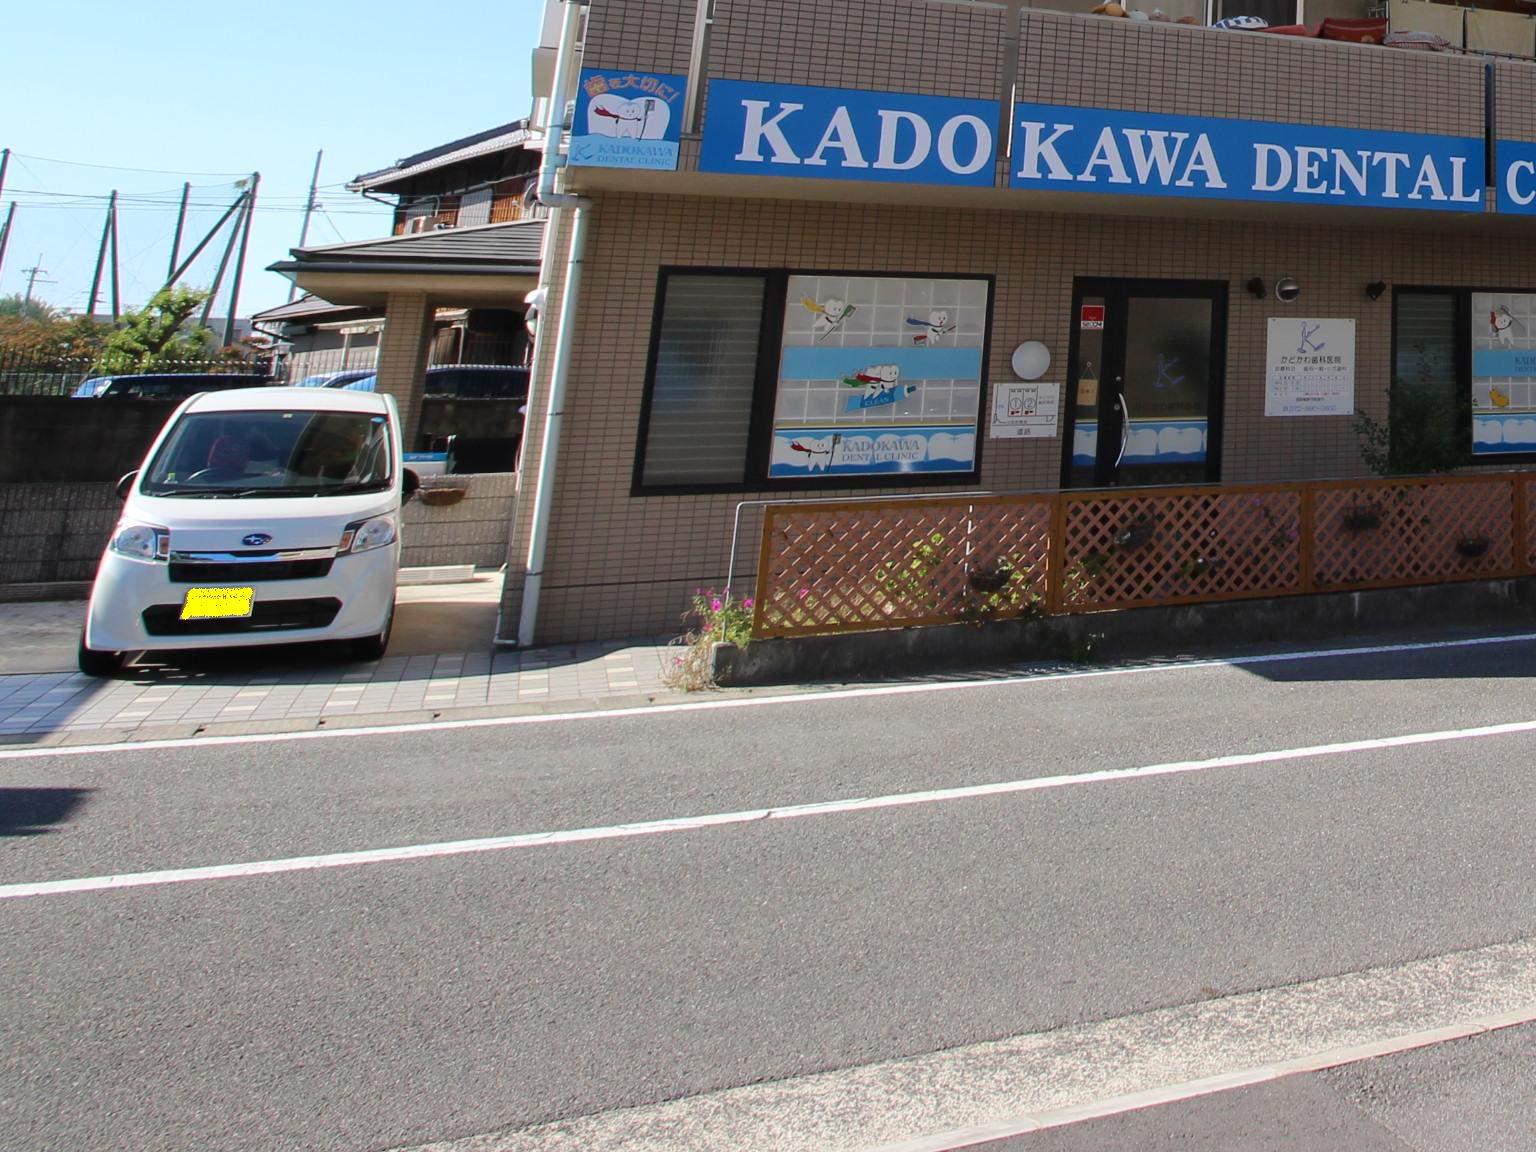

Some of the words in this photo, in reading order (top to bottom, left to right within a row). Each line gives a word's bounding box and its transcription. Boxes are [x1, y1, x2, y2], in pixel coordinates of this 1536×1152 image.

[599, 143, 673, 157] KADOKAWA
[735, 99, 992, 175] KADO
[1017, 121, 1227, 189] KAWA
[1252, 143, 1481, 203] DENTAL
[598, 156, 634, 164] DENTAL
[638, 156, 672, 166] CLINIC
[843, 439, 920, 452] KADOKAWA
[842, 453, 882, 462] DENTL
